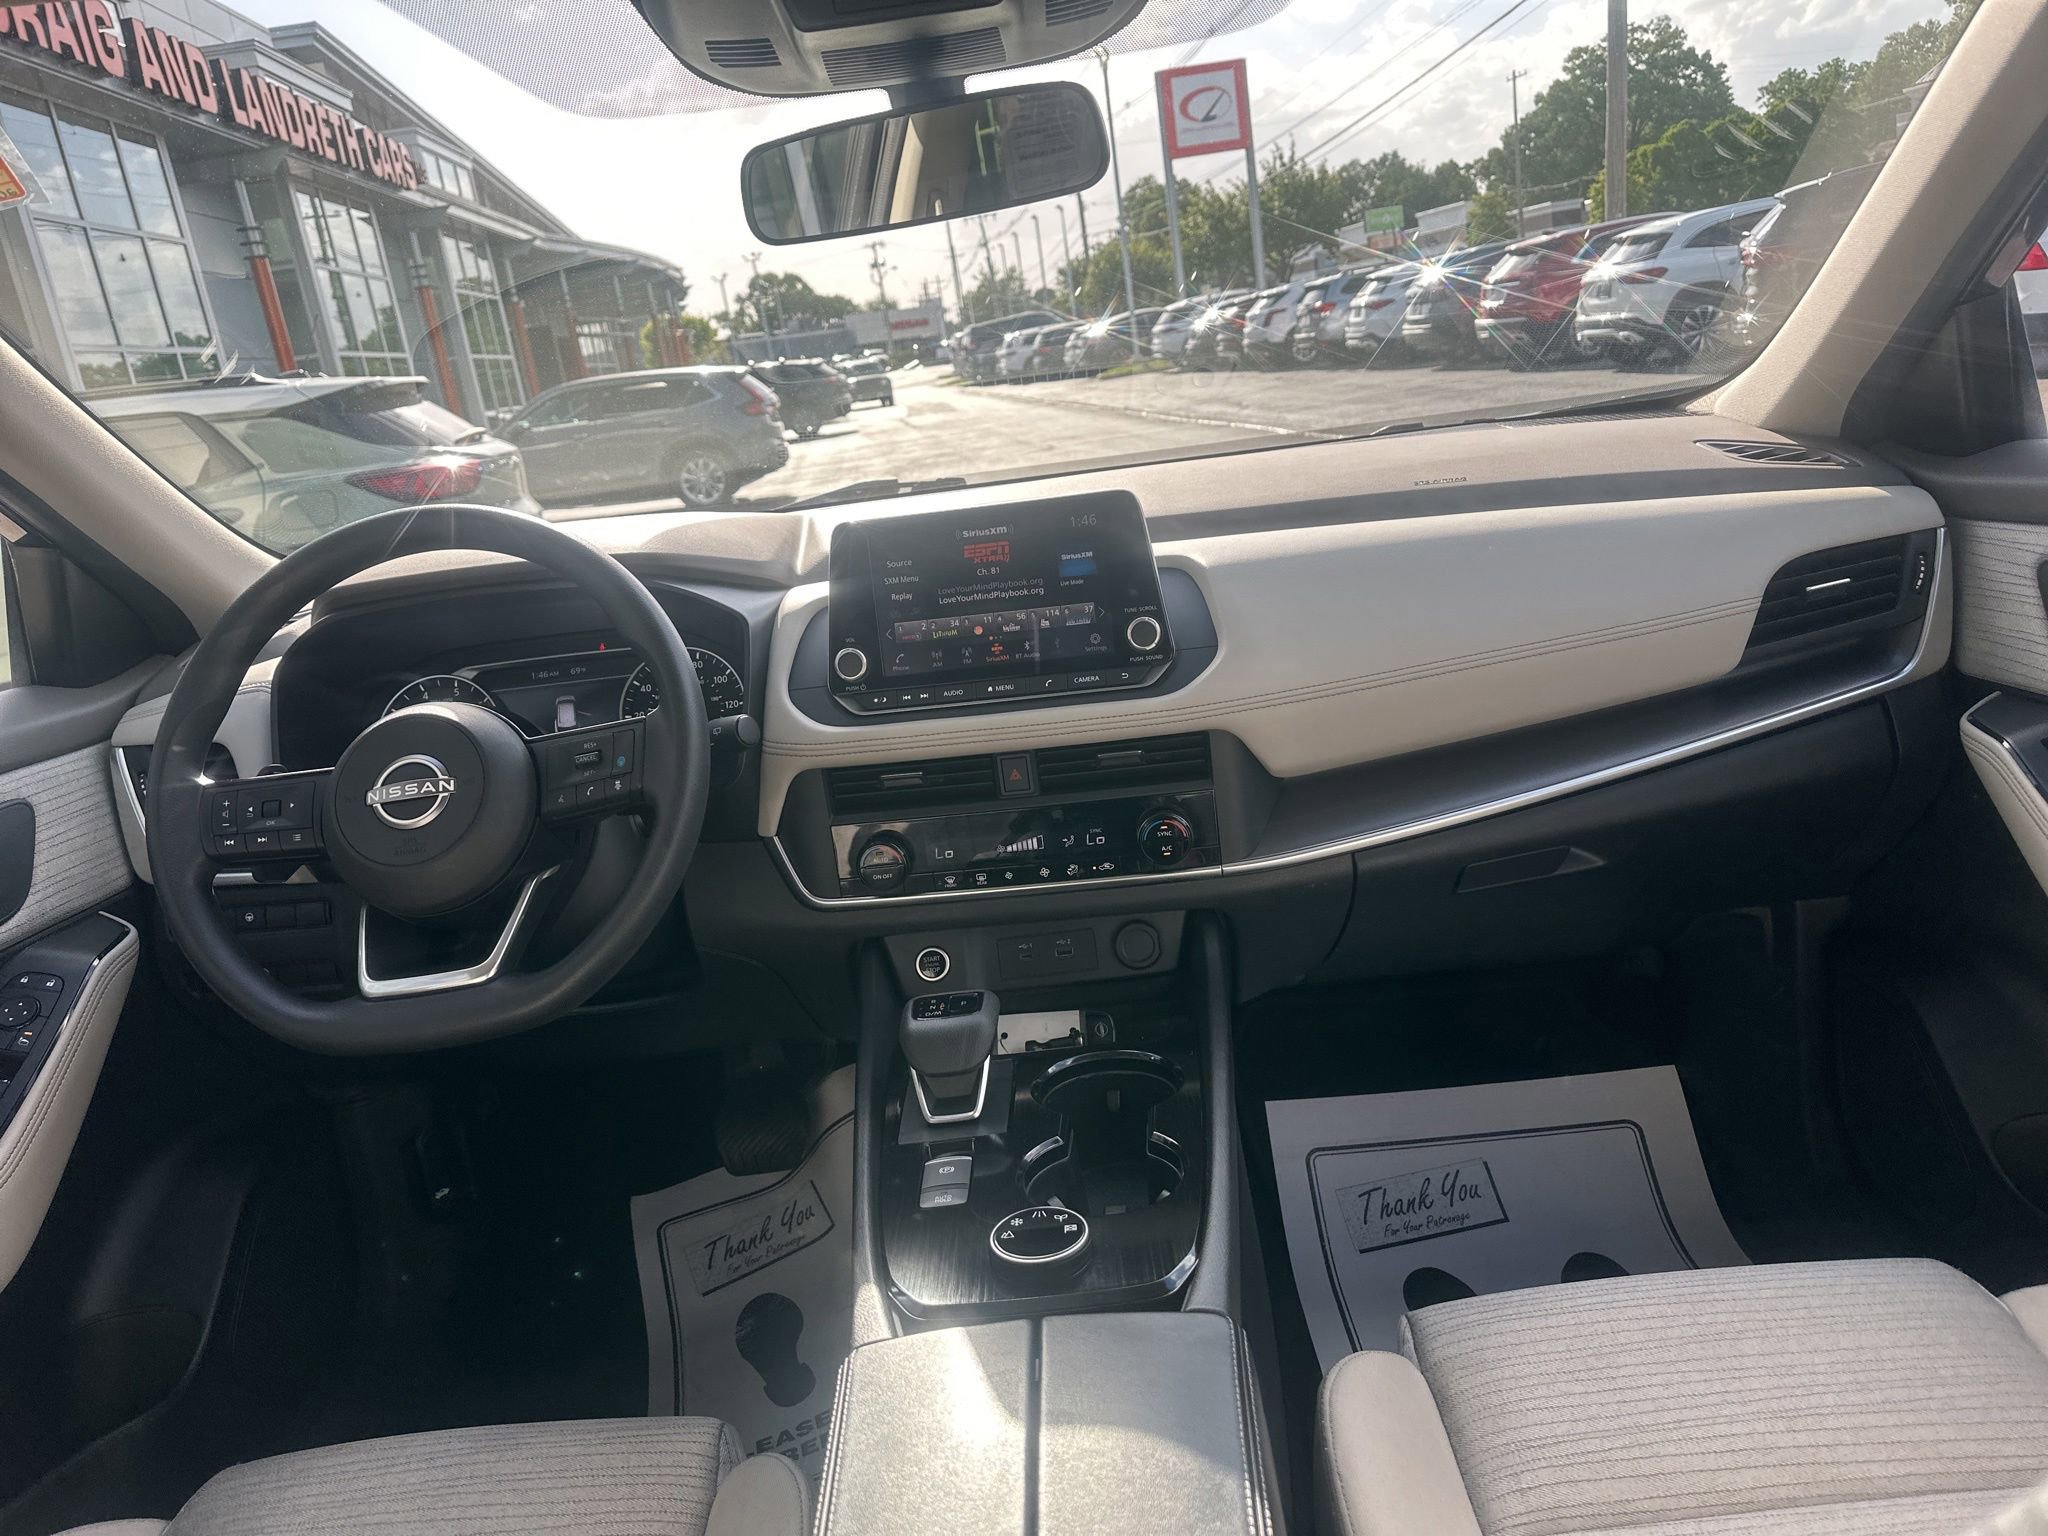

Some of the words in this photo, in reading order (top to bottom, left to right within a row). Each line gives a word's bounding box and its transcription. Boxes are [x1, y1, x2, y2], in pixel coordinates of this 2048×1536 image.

[0, 0, 125, 78] RAIG
[131, 17, 218, 114] AND
[219, 58, 366, 171] LANDRETH
[363, 125, 417, 190] CARS
[1071, 513, 1097, 528] 1:46
[964, 541, 1009, 558] ESPN
[886, 559, 912, 568] Source
[990, 566, 1000, 575] 81
[884, 577, 899, 585] SXM
[900, 575, 919, 584] Menu
[891, 592, 913, 602] Replay
[939, 586, 1045, 605] LoveYourMindPlaybook.org
[1046, 609, 1060, 617] 114
[1084, 605, 1094, 613] 37
[984, 616, 992, 624] 11
[1016, 612, 1026, 620] 56
[531, 671, 549, 680] 1:46
[713, 675, 728, 684] 100
[1074, 675, 1100, 684] CAMERA
[640, 684, 652, 692] 40
[995, 683, 1015, 691] MENU
[422, 691, 429, 700] 4
[454, 687, 460, 697] 5
[943, 689, 964, 697] AUDIO
[725, 699, 739, 708] 120
[367, 779, 455, 803] NISSAN
[923, 955, 941, 963] START
[1358, 1177, 1434, 1225] Thank
[1441, 1169, 1482, 1207] You
[1384, 1223, 1400, 1237] For
[1403, 1220, 1423, 1234] Your
[704, 1215, 774, 1270] Thank
[781, 1200, 815, 1233] You
